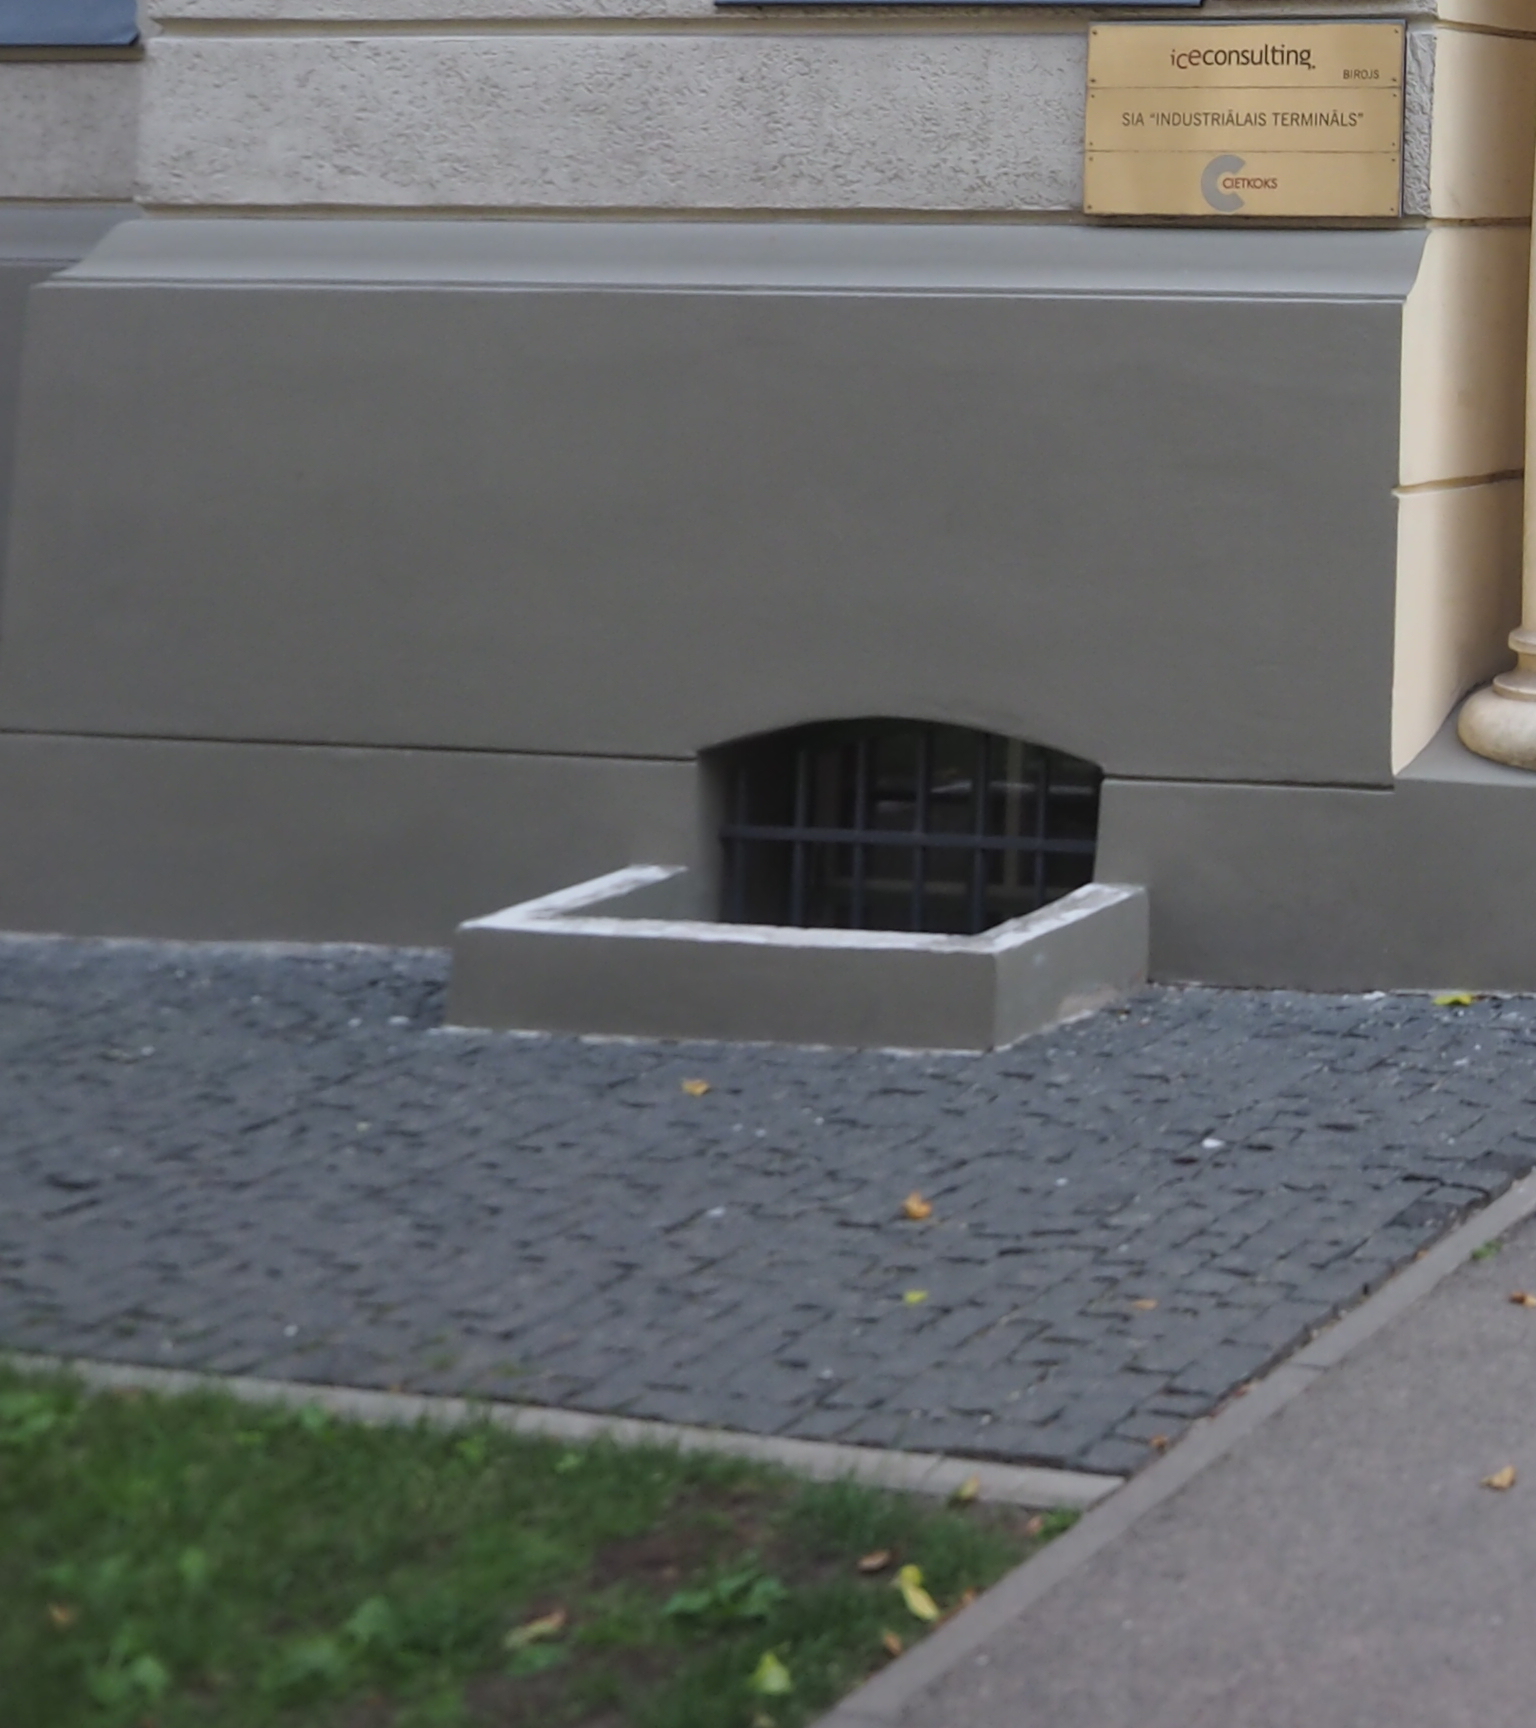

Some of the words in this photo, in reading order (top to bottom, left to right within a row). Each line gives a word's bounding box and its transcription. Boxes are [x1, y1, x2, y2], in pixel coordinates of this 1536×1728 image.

[1342, 69, 1380, 80] BIROJS
[1122, 112, 1145, 127] SIA
[1222, 177, 1278, 190] CIETKOKS
